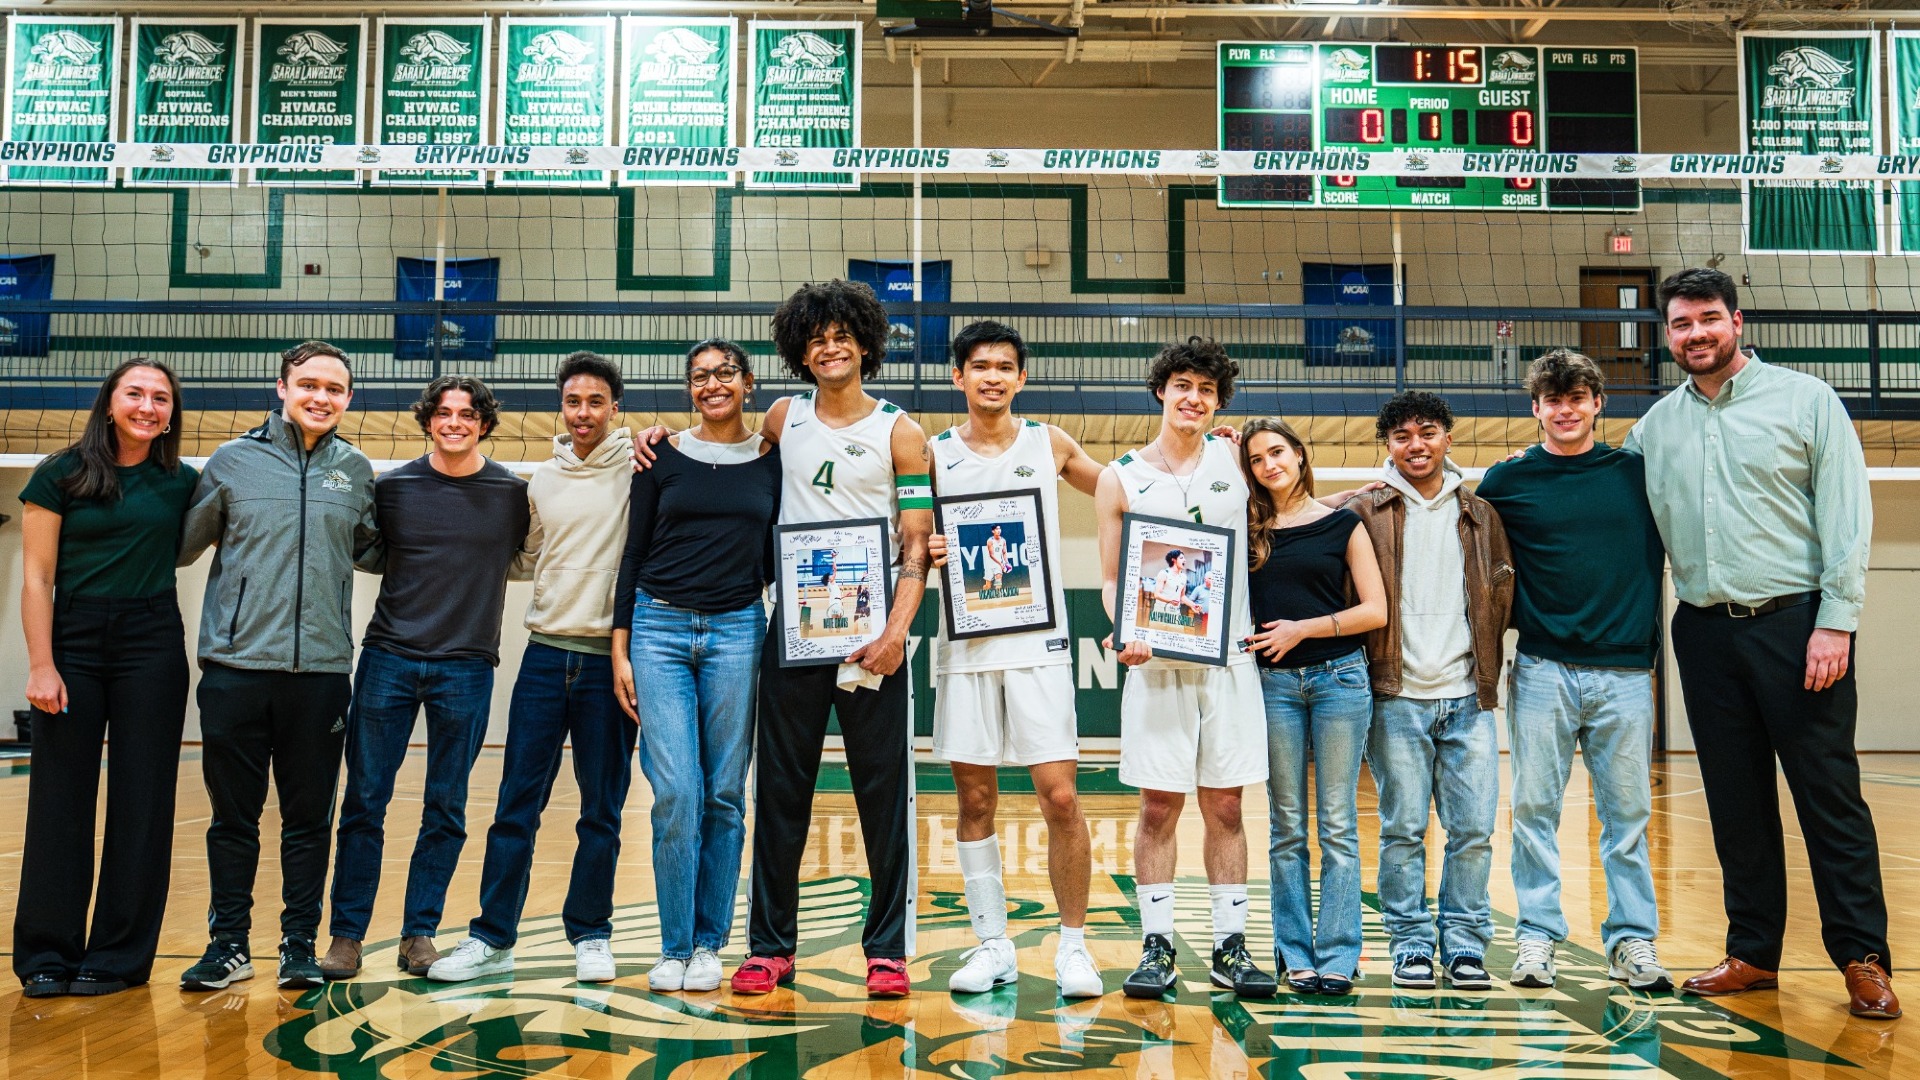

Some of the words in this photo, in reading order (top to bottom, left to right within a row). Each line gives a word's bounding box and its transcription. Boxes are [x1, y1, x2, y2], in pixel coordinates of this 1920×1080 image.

[1229, 49, 1250, 60] PLYR
[1260, 49, 1275, 60] FLS
[1552, 53, 1573, 64] PLYR
[1583, 53, 1598, 64] FLS
[1610, 54, 1625, 64] PTS
[1417, 50, 1479, 82] 1:15
[150, 65, 178, 80] SARAH
[177, 65, 221, 81] LAWRENCE
[272, 65, 301, 80] SARAH
[301, 65, 344, 81] LAWRENCE
[396, 65, 425, 80] SARAH
[424, 65, 468, 81] LAWRENCE
[767, 67, 797, 83] SARAH
[796, 67, 842, 83] LAWRENCE
[388, 90, 426, 98] WOMEN'S
[428, 90, 477, 98] VOLLEYBALL
[1331, 88, 1378, 104] HOME
[1479, 90, 1531, 106] GUEST
[1765, 87, 1799, 106] SARAH
[1798, 87, 1851, 106] LAWRENCE
[34, 101, 91, 112] HVWAC
[157, 102, 213, 113] HVWAC
[280, 102, 337, 113] HVMAC
[404, 102, 460, 113] HVWAC
[528, 102, 584, 113] HVWAC
[758, 105, 795, 116] SKYLINE
[797, 105, 851, 116] CONFERENCE
[1410, 98, 1450, 110] PERIOD
[15, 113, 107, 126] CHAMPIONS
[138, 114, 230, 127] CHAMPIONS
[262, 114, 353, 127] CHAMPIONS
[386, 114, 478, 127] CHAMPIONS
[509, 115, 601, 127] CHAMPIONS
[632, 114, 724, 127] CHAMPIONS
[758, 117, 850, 130] CHAMPIONS
[1361, 109, 1382, 143] 0
[1752, 119, 1781, 131] 1,000
[1783, 120, 1817, 131] POINT
[1819, 121, 1869, 131] SCORERS
[1432, 115, 1439, 139] 1
[1511, 111, 1532, 144] 0
[388, 131, 428, 144] 1996
[434, 132, 473, 144] 1997
[634, 131, 676, 144] 2021
[759, 135, 803, 147] 2022
[1762, 137, 1803, 147] GILLERAN
[1818, 137, 1840, 147] 2017
[1, 142, 116, 162] GRYPHONS
[208, 145, 324, 163] GRYPHONS
[415, 146, 531, 164] GRYPHONS
[623, 148, 740, 166] GRYPHONS
[833, 149, 950, 168] GRYPHONS
[1044, 151, 1161, 169] GRYPHONS
[1254, 152, 1370, 171] GRYPHONS
[1463, 154, 1579, 173] GRYPHONS
[1669, 155, 1786, 174] GRYPHONS
[1323, 191, 1359, 203] SCORE
[1412, 193, 1451, 205] MATCH
[1502, 193, 1538, 205] SCORE
[1614, 237, 1632, 253] EXIT
[444, 280, 462, 288] CAA
[1343, 285, 1369, 294] NCAA
[812, 460, 835, 495] 4
